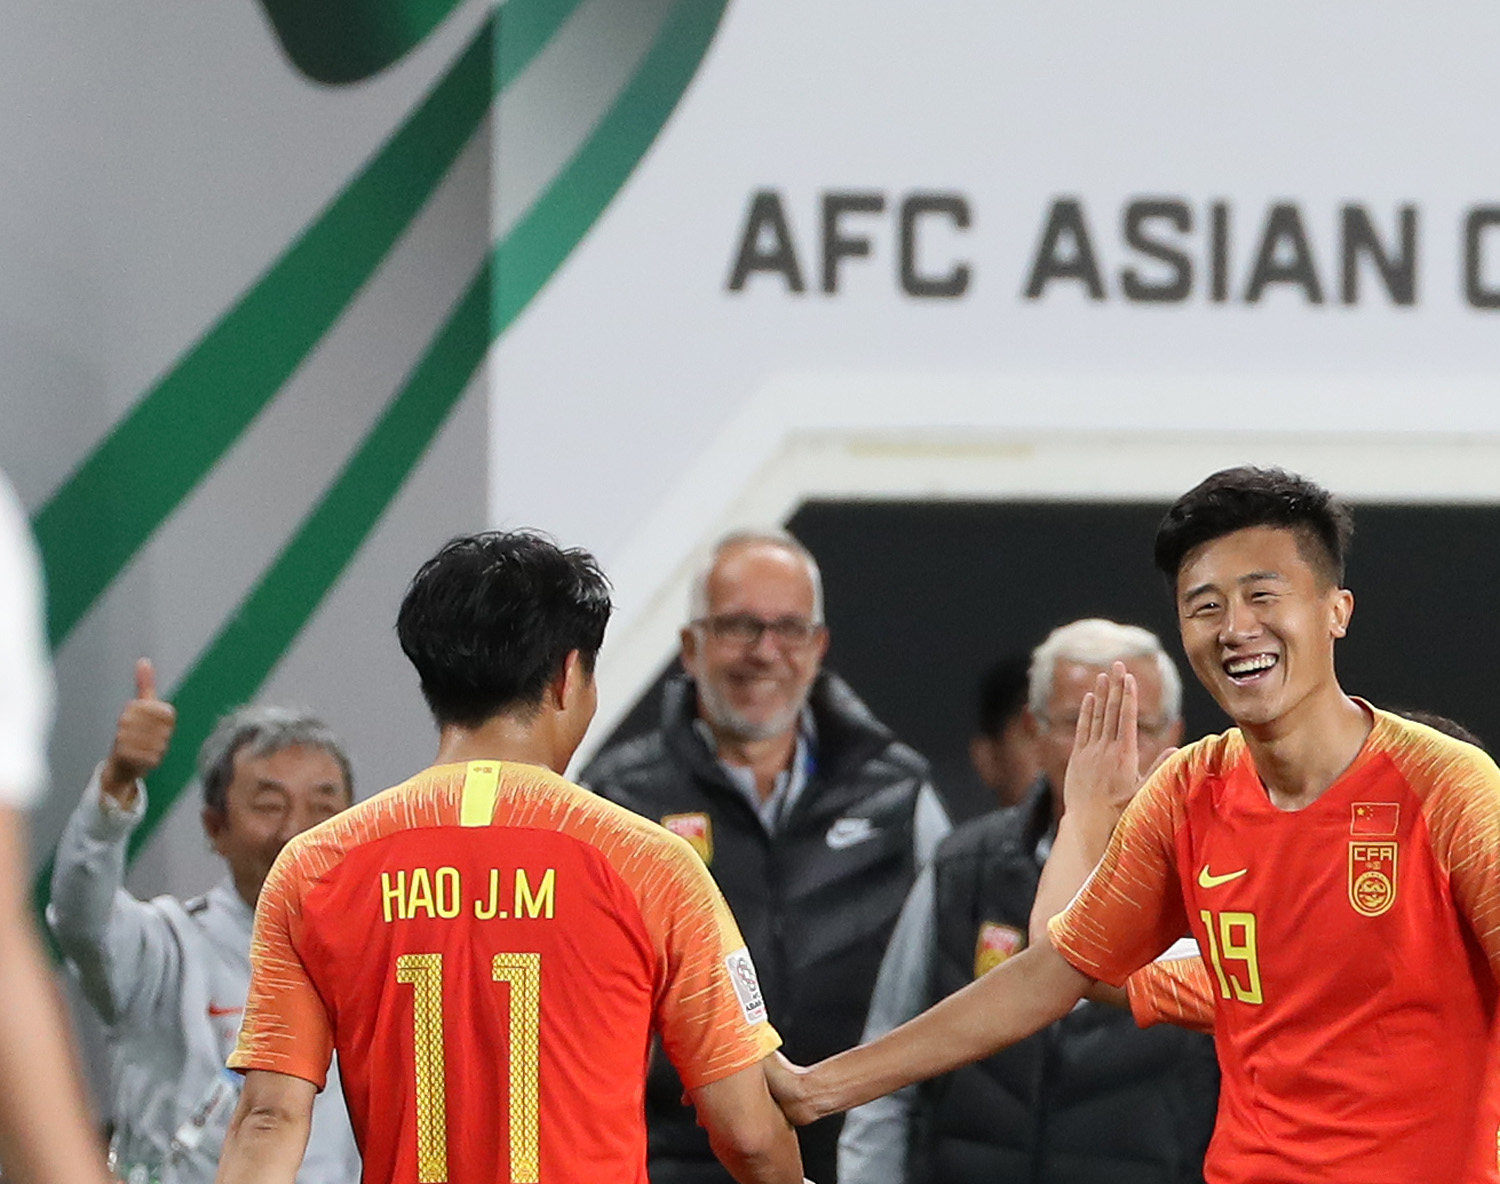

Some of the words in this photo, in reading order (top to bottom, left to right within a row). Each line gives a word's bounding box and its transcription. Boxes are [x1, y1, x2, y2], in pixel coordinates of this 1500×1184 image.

[727, 189, 971, 299] AFC
[1021, 197, 1418, 307] ASIAN
[381, 867, 461, 922] HAO
[474, 868, 556, 920] J.M
[1354, 847, 1393, 861] CFA
[1200, 909, 1263, 1005] 19
[396, 953, 541, 1184] 11
